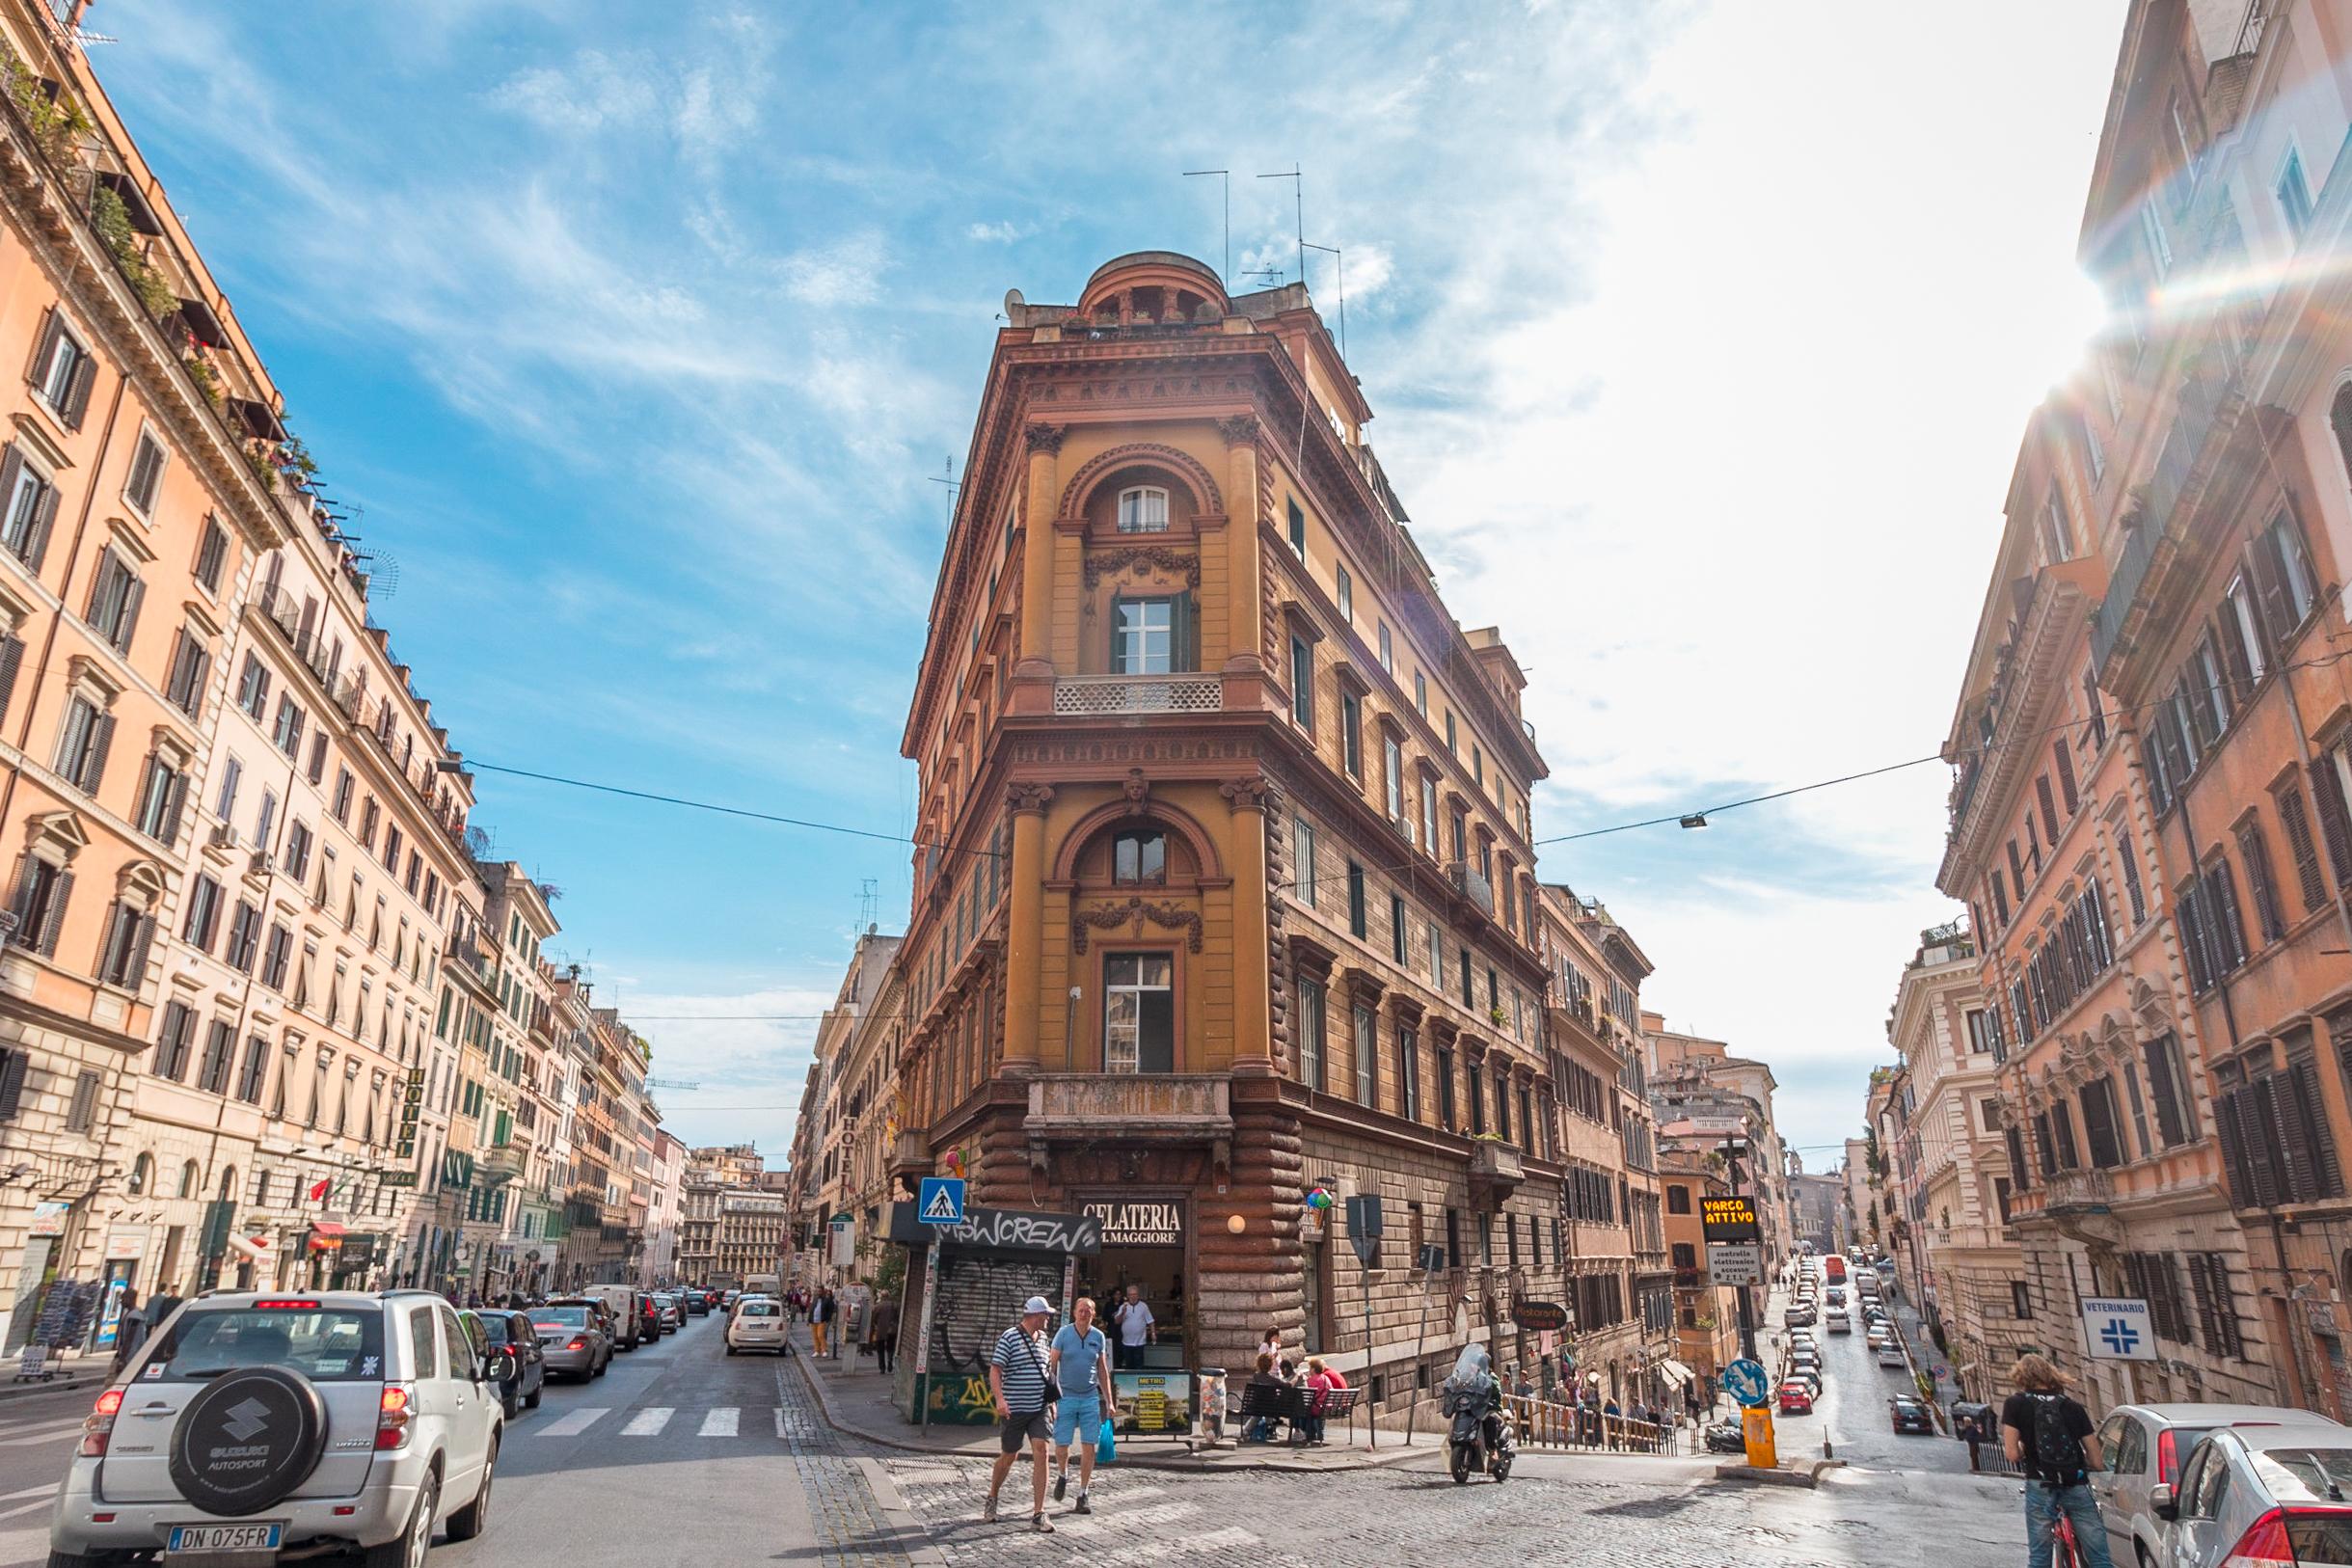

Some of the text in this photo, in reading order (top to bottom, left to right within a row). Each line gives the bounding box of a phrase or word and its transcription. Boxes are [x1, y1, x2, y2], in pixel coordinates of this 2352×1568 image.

[397, 1069, 424, 1157] HOTEL
[840, 1118, 855, 1188] HOTEL
[1703, 1200, 1744, 1212] VARCO
[1705, 1211, 1755, 1224] ATTIVO
[1110, 1231, 1176, 1244] MAGGIORE
[1714, 1257, 1755, 1266] elettronico
[2085, 1302, 2145, 1313] VETERINARIO
[208, 1459, 267, 1471] AUTOSPORT
[182, 1527, 268, 1549] DN 075FR
